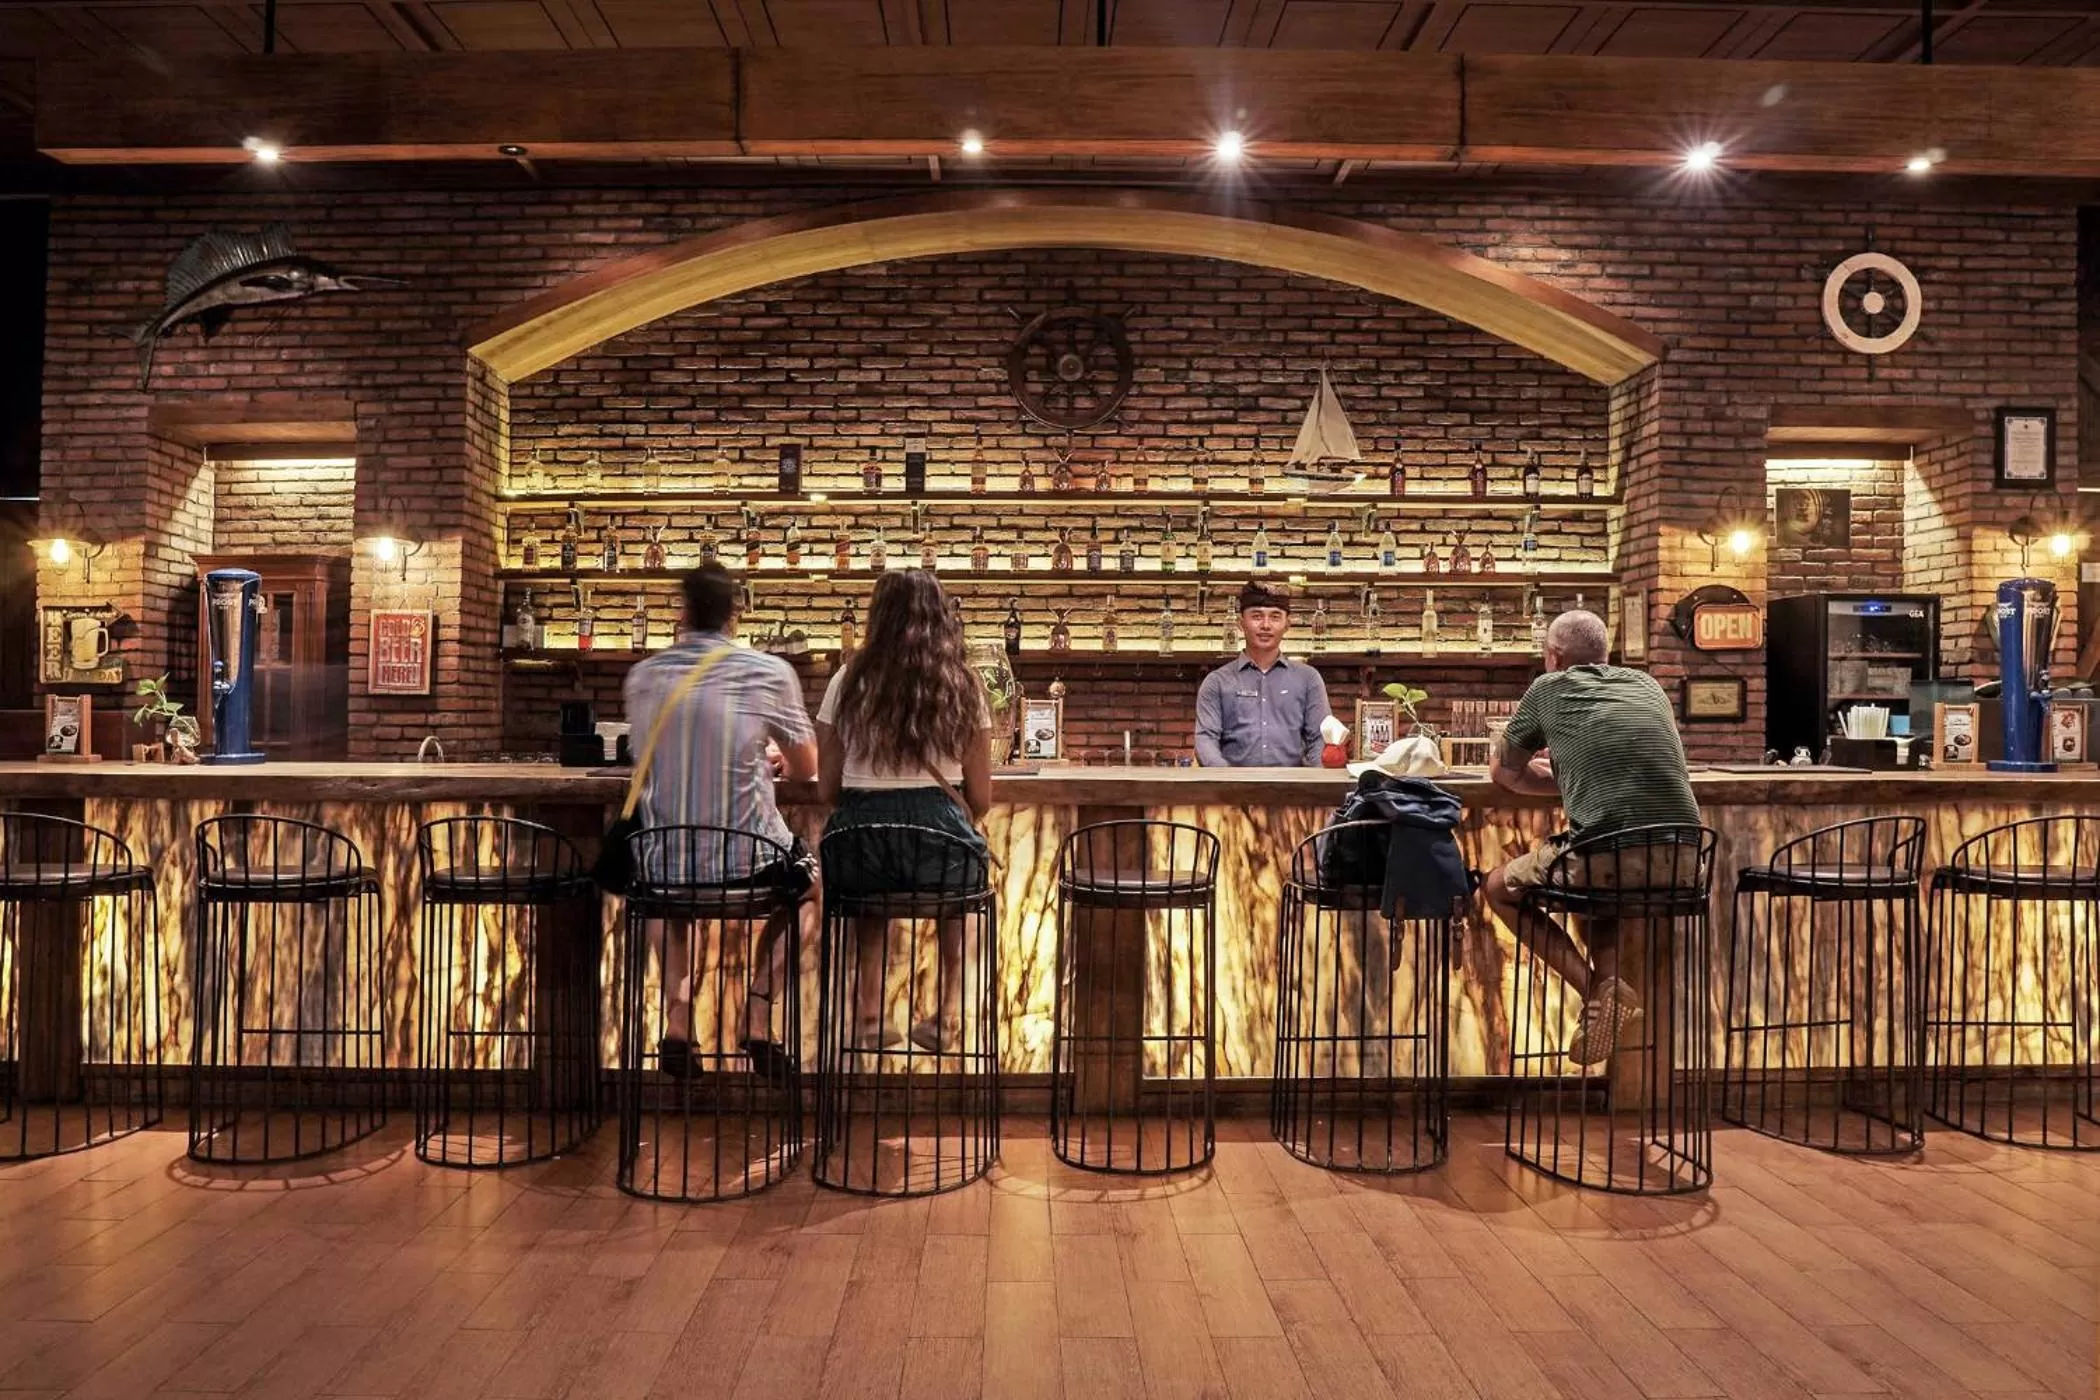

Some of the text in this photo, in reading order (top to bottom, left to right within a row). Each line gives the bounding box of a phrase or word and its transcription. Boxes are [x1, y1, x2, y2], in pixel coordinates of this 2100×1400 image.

[379, 618, 411, 636] COLD
[1700, 613, 1752, 640] OPEN
[379, 637, 422, 663] BEER
